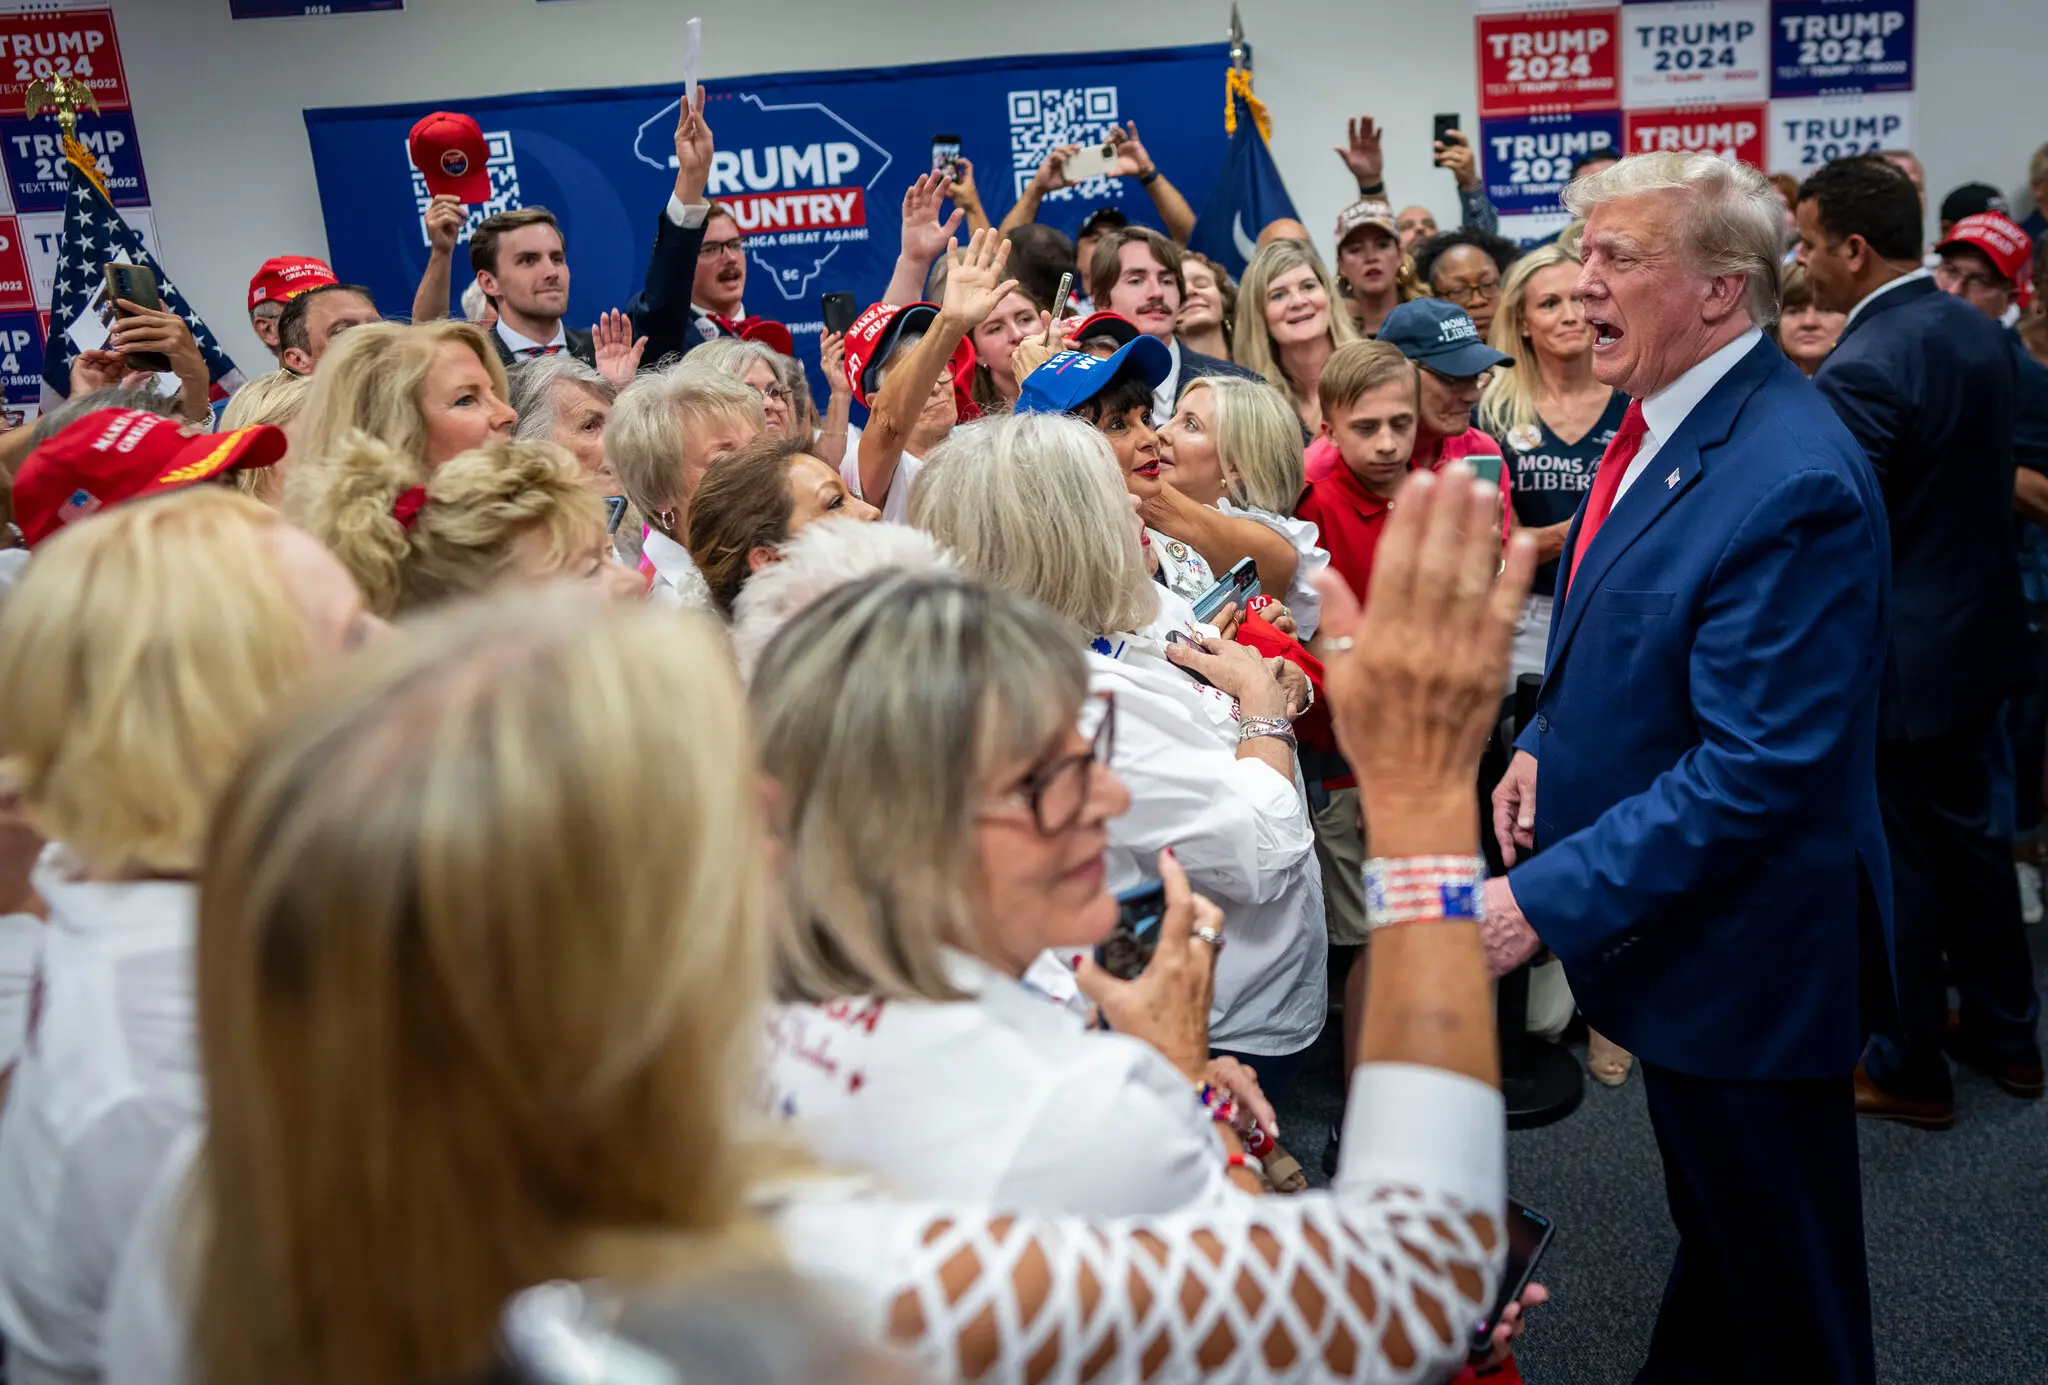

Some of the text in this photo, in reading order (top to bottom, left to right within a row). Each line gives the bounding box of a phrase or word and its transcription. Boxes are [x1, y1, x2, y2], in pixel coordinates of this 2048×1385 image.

[1636, 21, 1754, 48] TRUMP
[1780, 11, 1905, 41] TRUMP
[1487, 28, 1609, 58] TRUMP
[1797, 38, 1886, 64] 2024
[13, 55, 94, 80] 2024
[1506, 54, 1592, 81] 2024
[1654, 47, 1737, 71] 2024
[1634, 121, 1757, 151] TRUMP
[1783, 116, 1900, 142] TRUMP
[1490, 130, 1612, 161] TRUMP
[34, 155, 114, 180] 204
[1510, 157, 1573, 184] 202
[778, 231, 821, 246] GREAT
[823, 226, 870, 242] AGAIN!
[782, 269, 800, 281] SC
[848, 309, 878, 340] MAKE
[1439, 316, 1467, 331] MOMS
[1518, 454, 1584, 474] MOMS
[1518, 471, 1597, 491] LIBER
